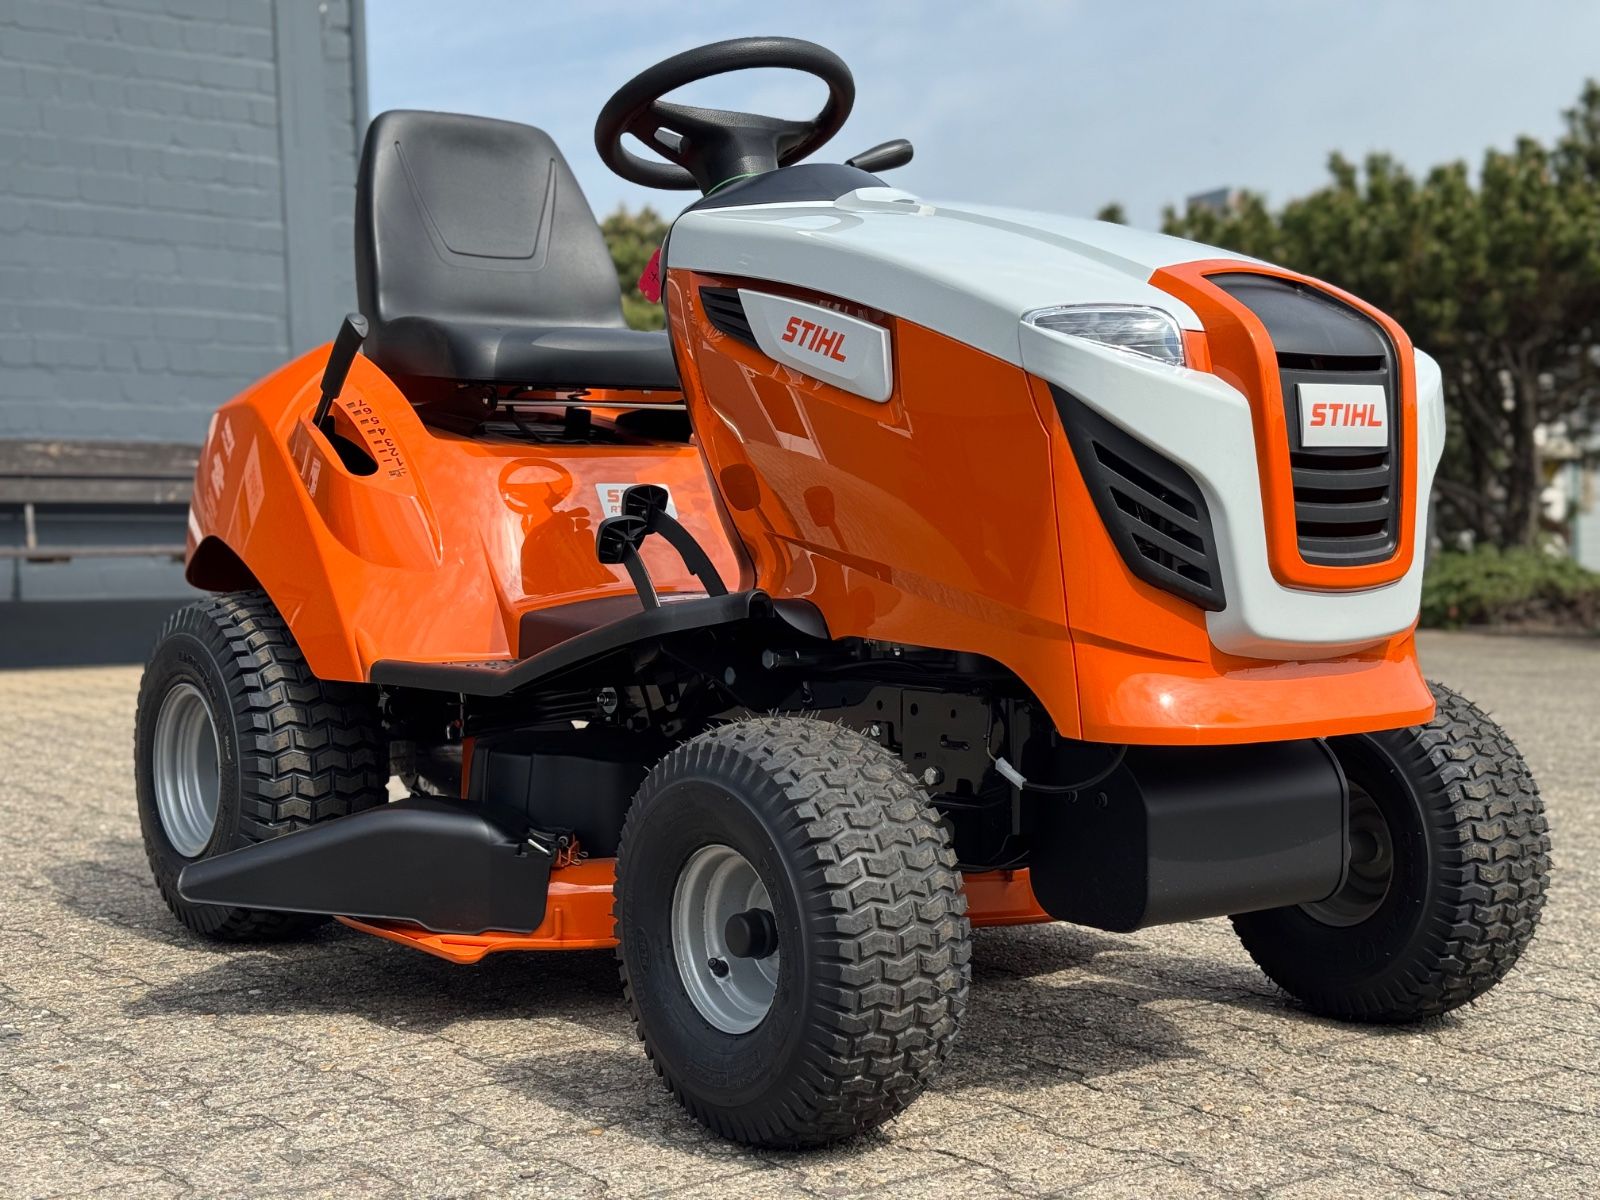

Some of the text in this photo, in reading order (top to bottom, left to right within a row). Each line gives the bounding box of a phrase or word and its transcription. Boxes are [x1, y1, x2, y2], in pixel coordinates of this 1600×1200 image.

[781, 316, 847, 362] STIHL
[359, 399, 367, 407] 7
[362, 407, 373, 415] 6
[1310, 403, 1383, 427] STIHL
[370, 416, 380, 425] 5
[377, 427, 386, 436] 4
[384, 438, 394, 447] 3
[388, 447, 399, 457] 2
[396, 457, 403, 467] 1
